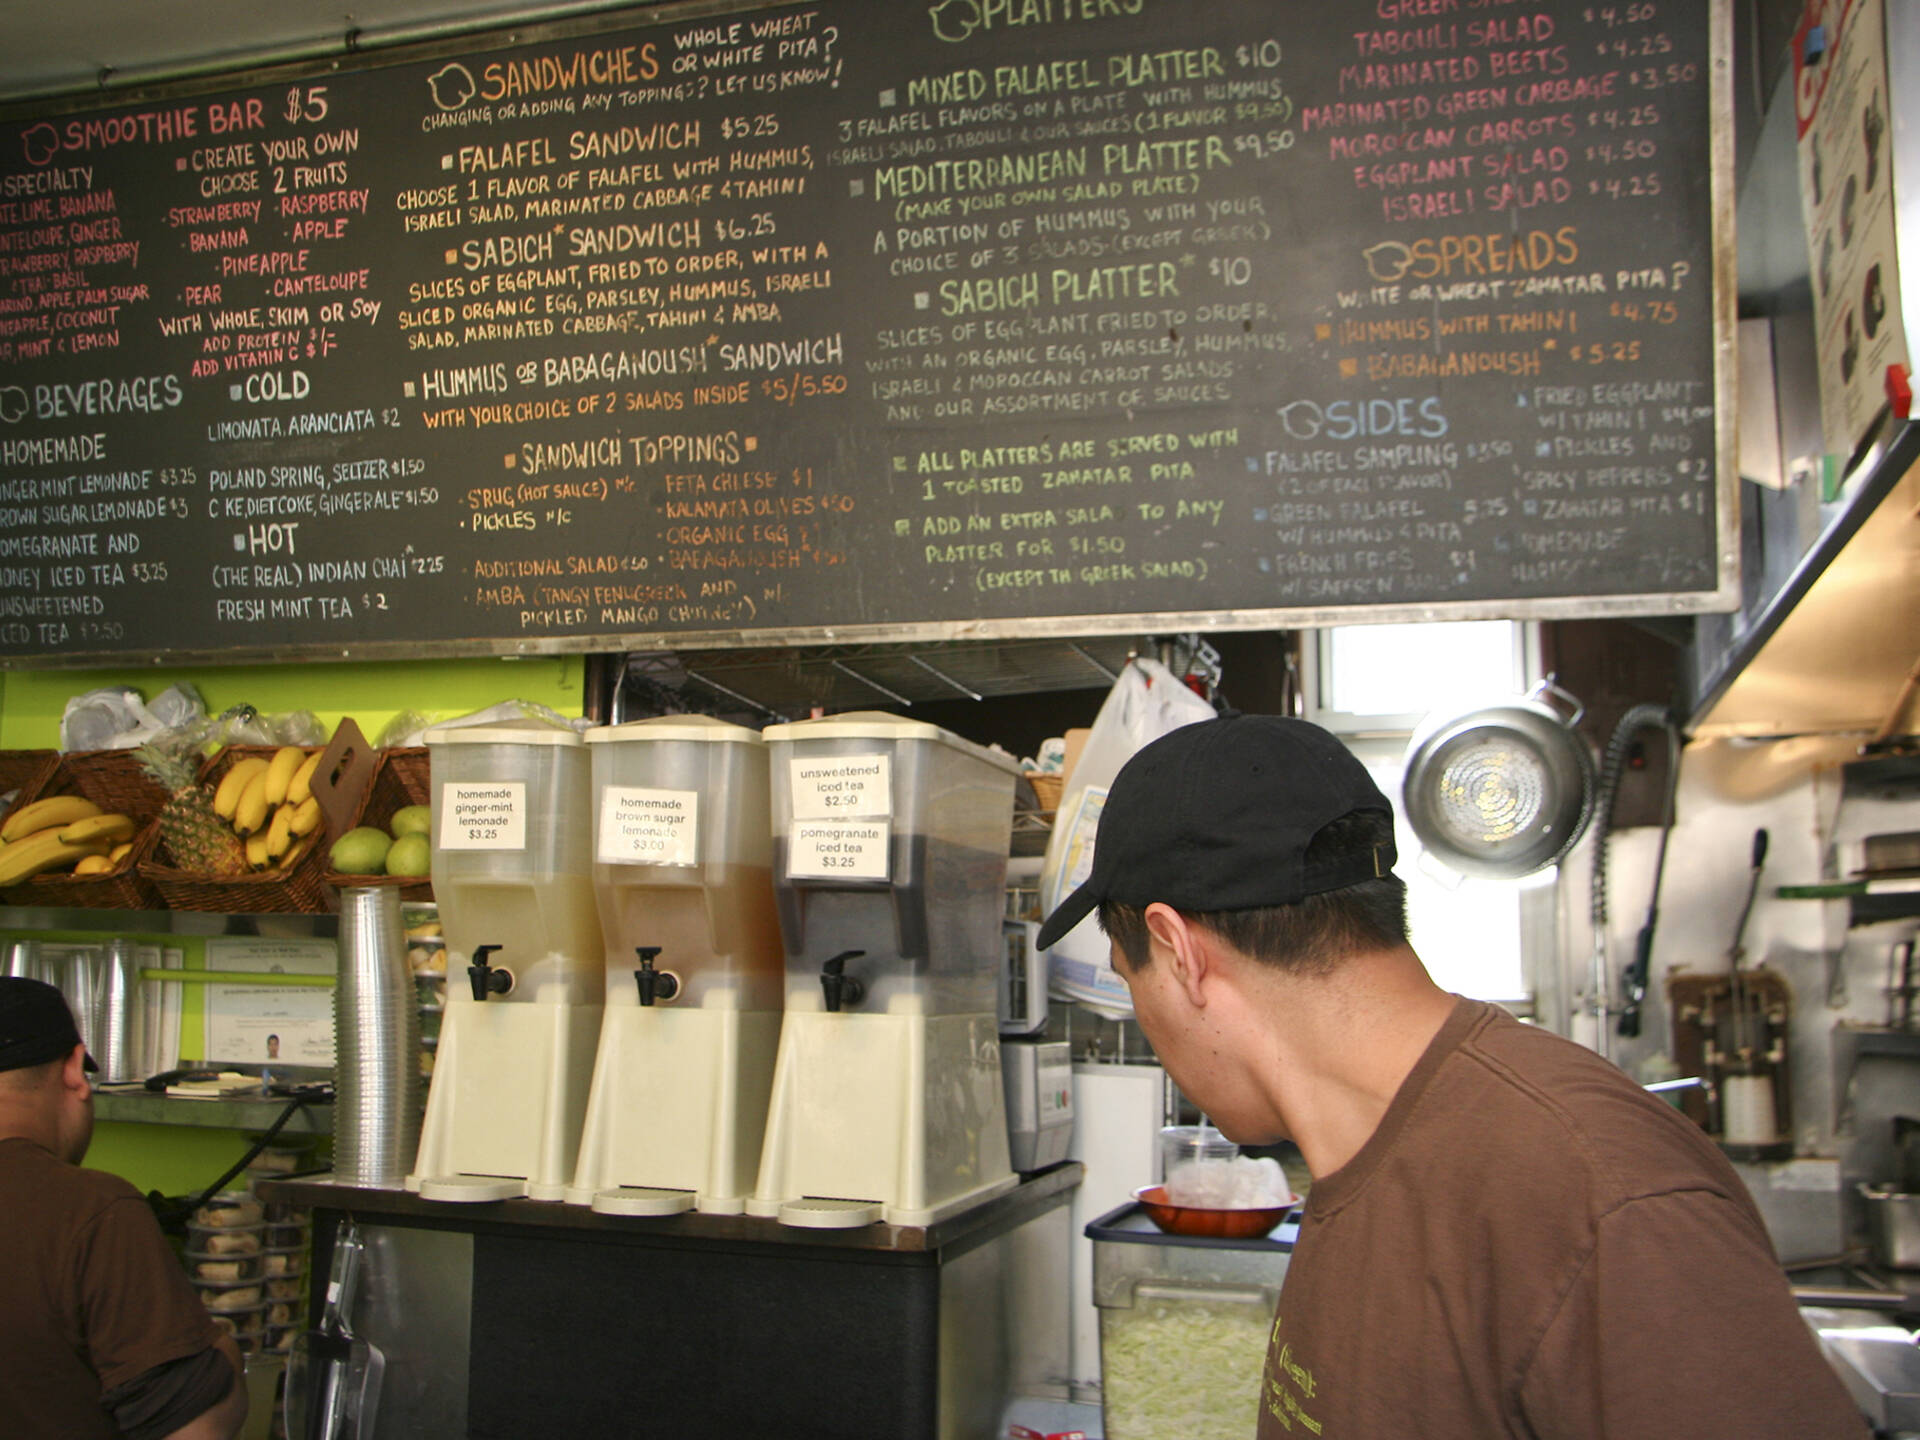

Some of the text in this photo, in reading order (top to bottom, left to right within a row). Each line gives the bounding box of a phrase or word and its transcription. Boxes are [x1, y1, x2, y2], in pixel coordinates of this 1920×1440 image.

[674, 12, 818, 50] WHOLE WHEAT
[1354, 14, 1555, 56] TABOULI SALAD
[481, 43, 659, 101] SANDWICHES
[672, 44, 764, 73] OR WHITE
[908, 39, 1282, 106] MIXED FALAFEL PLATTER $10
[1339, 45, 1568, 93] MARINATED BEETS
[422, 74, 777, 132] CHANGING OR ADDING LET US
[1302, 71, 1620, 132] MARINATED GREEN CABBAGE
[63, 86, 328, 150] SMOOTHIE BAR $5
[857, 112, 932, 137] FALAFEL
[1466, 105, 1660, 146] CARROTS $4.25
[192, 128, 358, 171] CREATE YOUR OWN
[459, 120, 700, 173] FALAFEL SANDWICH
[1483, 146, 1568, 177] SALAD
[4, 166, 93, 197] SPECIALTY
[201, 161, 348, 198] CHOOSE 2 FRUITS
[397, 185, 458, 210] CHOOSE
[488, 174, 550, 199] FLAVOR
[557, 171, 580, 190] OF
[588, 164, 663, 190] FALAFEL
[673, 156, 720, 180] WITH
[876, 148, 1086, 201] MEDITERRANEAN
[1103, 136, 1232, 175] PLATTER
[405, 184, 713, 232] ISRAELI SALAD, MARINATED CABBAGE
[958, 193, 1006, 216] YOUR
[1383, 178, 1572, 222] ISRAELI SALAD
[569, 212, 776, 256] SANDWICH $6.25
[897, 224, 988, 250] PORTION
[1036, 207, 1131, 234] HUMMUS
[1412, 226, 1578, 278] SPREADS
[410, 277, 465, 303] SLICES
[470, 275, 490, 295] OF
[588, 259, 641, 284] FRIED
[645, 257, 668, 275] TO
[752, 246, 806, 264] WITH
[815, 241, 829, 259] A
[940, 272, 1039, 317] SABICH
[1208, 257, 1251, 286] $10
[462, 270, 830, 319] ORGANIC ISRAELI
[159, 302, 344, 337] WITH SKIM OR
[464, 319, 553, 343] MARINATED
[1497, 309, 1577, 334] TAHINI
[203, 330, 300, 352] ADD PROTEIN
[191, 346, 299, 377] ADD VITAMIN C
[422, 332, 843, 400] HUMMUS SANDWICH
[35, 374, 183, 420] BEVERAGES
[246, 371, 310, 403] COLD
[423, 382, 750, 429] WITH OF 2 SALADS INSIDE
[1325, 397, 1448, 439] SIDES
[288, 409, 375, 434] ARANCIATA
[4, 433, 107, 466] HOMEMADE
[522, 431, 740, 475] SANDWICH TOPPINGS
[917, 428, 1238, 474] ALL PLATTERS ARE WITH
[79, 470, 152, 493] LEMONADE
[210, 459, 389, 492] POLAND SELTZER
[1151, 461, 1195, 482] PITA
[42, 496, 167, 526] SUGAR LEMONADE
[473, 511, 536, 532] PICKLES
[923, 517, 962, 537] ADD
[1001, 510, 1058, 530] EXTRA
[108, 533, 140, 554] AND
[249, 522, 299, 556] HOT
[1016, 537, 1054, 556] FOR
[51, 563, 125, 587] ICED TEA
[308, 560, 366, 582] INDIAN
[567, 556, 617, 575] SALAD
[217, 597, 352, 621] FRESH MINT TEA
[800, 765, 880, 779] unsweetened
[817, 781, 864, 792] iced tea
[455, 803, 513, 814] ginger-mint
[457, 788, 512, 799] homemade
[621, 797, 682, 809] homemade
[825, 795, 857, 807] $2.50
[458, 816, 508, 826] lemonade
[615, 811, 685, 825] brown sugar
[622, 825, 677, 838] lemonade
[468, 829, 498, 840] $3.25
[800, 828, 879, 840] pomegranate
[816, 843, 863, 853] iced tea
[822, 856, 855, 868] $3.25
